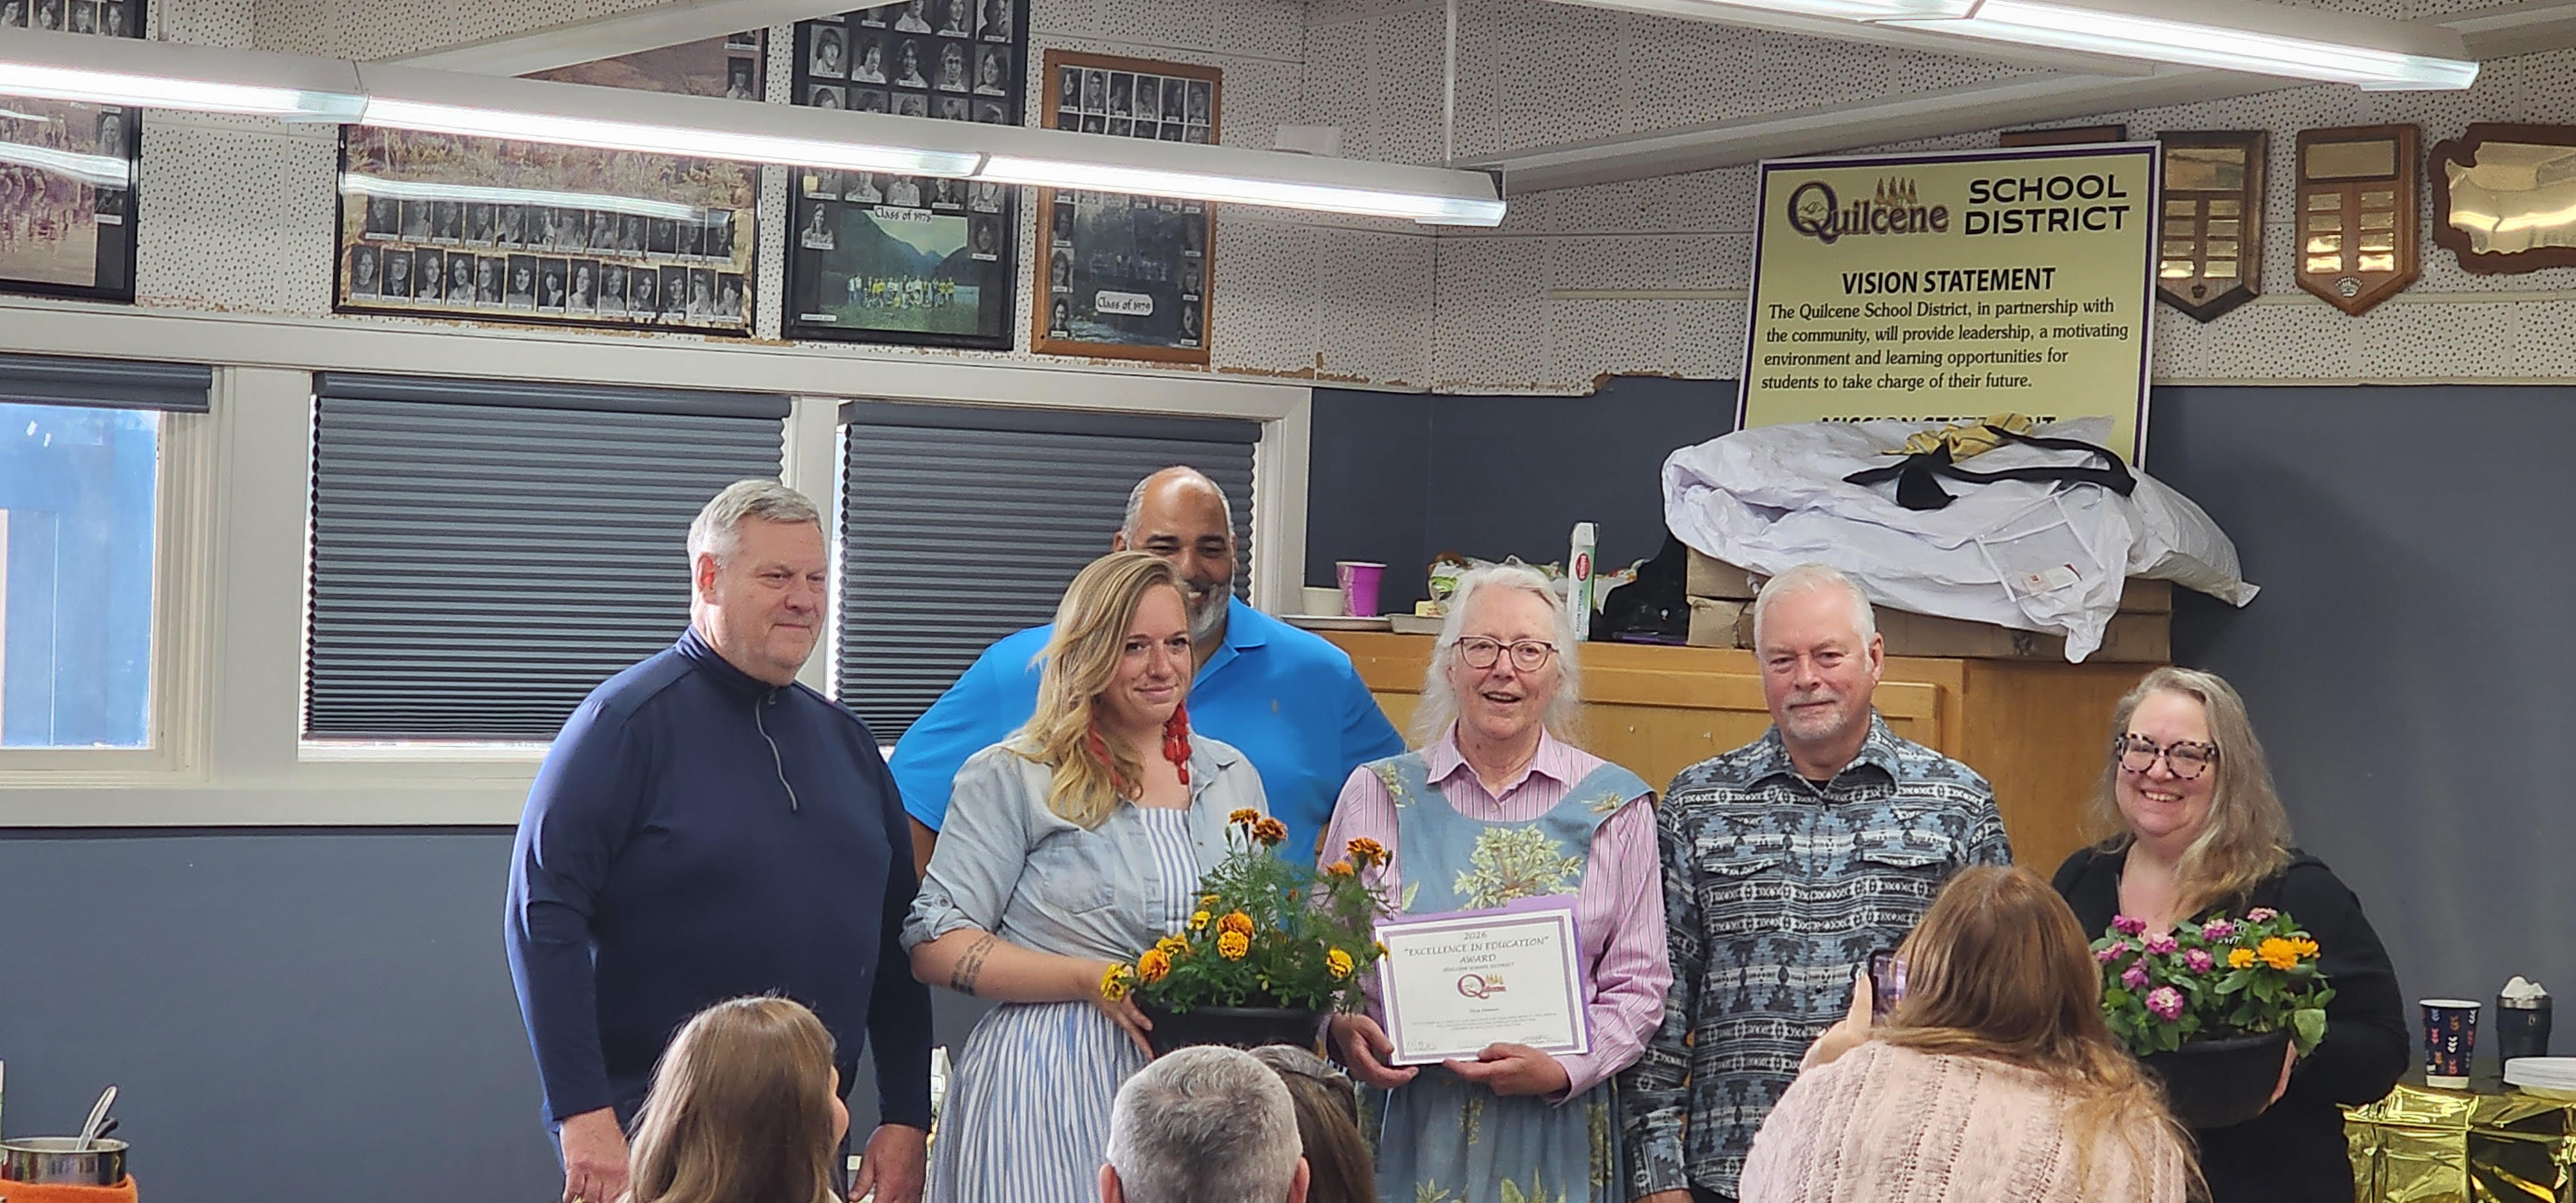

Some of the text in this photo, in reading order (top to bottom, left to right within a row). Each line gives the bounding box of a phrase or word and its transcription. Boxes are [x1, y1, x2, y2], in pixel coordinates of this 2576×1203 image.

[1969, 174, 2127, 204] SCHOOL
[875, 207, 900, 220] Class
[902, 209, 913, 221] of
[1788, 180, 1949, 244] Quilcene
[1964, 205, 2130, 236] DISTRICT
[1842, 267, 2056, 295] VISION STATEMENT
[1097, 296, 1119, 309] Class
[1122, 298, 1133, 310] of
[1768, 296, 2114, 321] The Quilcene School District, in partnership with
[1766, 323, 2128, 345] the community, will provide leadership, a motivating
[1764, 346, 2069, 368] environment and learning opportunities for
[1761, 372, 2032, 392] students to take charge of their future.
[1403, 936, 1549, 957] "EXCELLENCE IN EDUCATION"
[1463, 931, 1488, 940] 2026
[1459, 954, 1497, 964] AWARD
